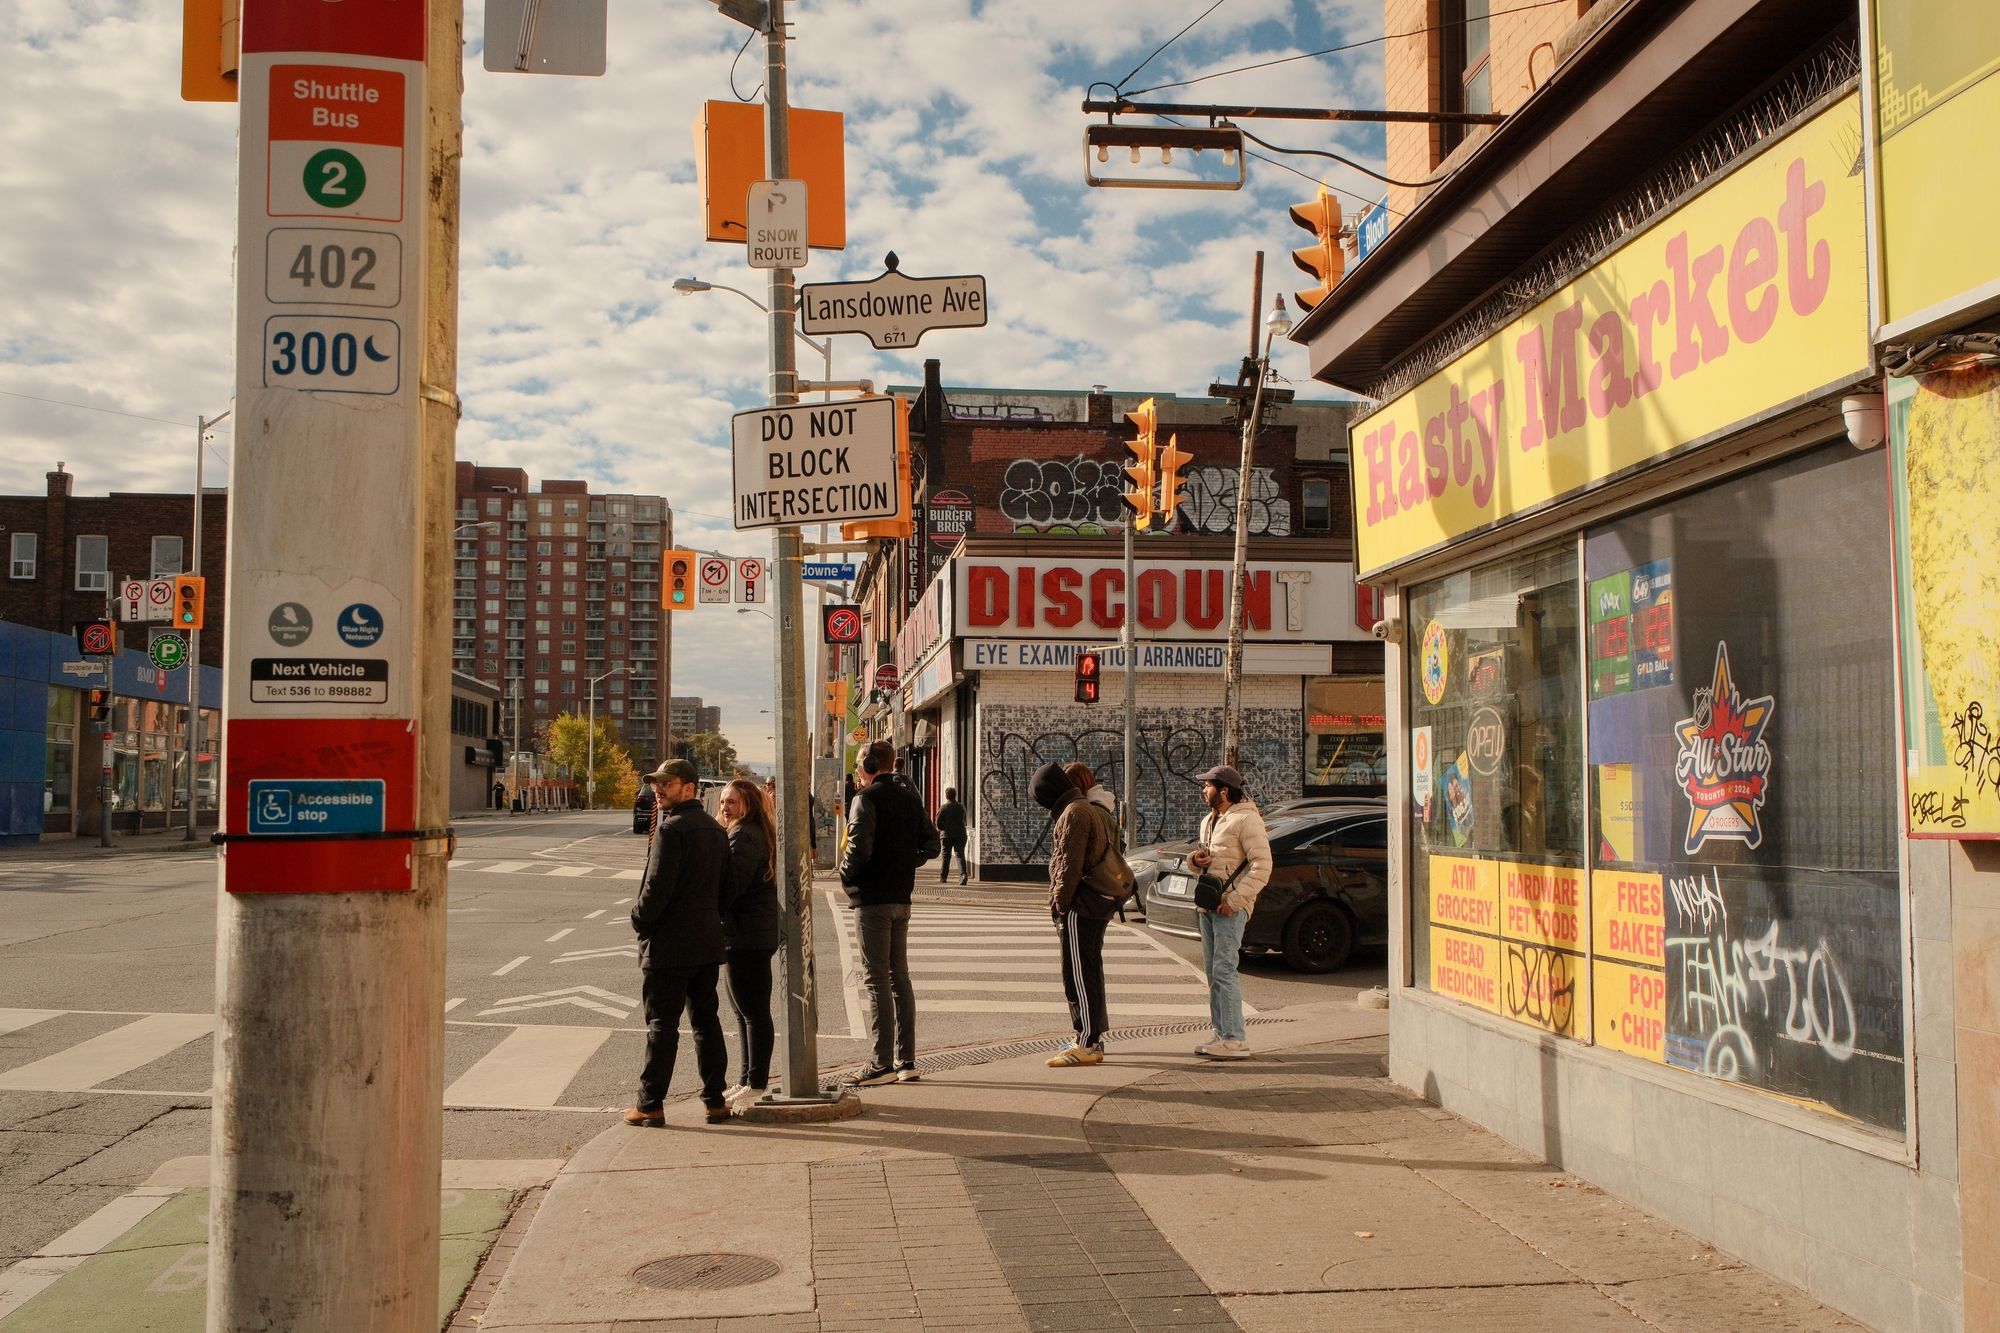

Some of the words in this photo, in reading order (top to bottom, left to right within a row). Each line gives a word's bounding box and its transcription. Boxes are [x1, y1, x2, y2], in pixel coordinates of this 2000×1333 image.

[293, 79, 380, 103] Shuttle
[312, 106, 360, 128] Bus
[320, 160, 347, 195] 2
[757, 229, 798, 243] SNOW
[1365, 212, 1385, 252] Bloor
[754, 247, 802, 261] ROUTE
[289, 244, 377, 291] 402
[807, 291, 933, 321] Lansdowne
[942, 286, 981, 314] Ave
[1516, 157, 1831, 452] Market
[884, 332, 906, 344] 671
[271, 331, 357, 377] 300
[761, 414, 794, 442] DO
[810, 408, 857, 438] NOT
[769, 447, 851, 479] BLOCK
[1364, 378, 1504, 527] Hasty
[741, 482, 888, 521] INTERSECTION
[930, 510, 973, 522] BURGER
[937, 521, 966, 533] BROS
[802, 564, 839, 577] downe
[841, 564, 853, 573] Ave
[968, 565, 1311, 632] DISCOUNT
[1600, 592, 1620, 616] MAX
[271, 625, 309, 634] Community
[345, 633, 375, 641] Network
[359, 626, 379, 635] Night
[161, 643, 177, 658] P
[976, 643, 1008, 665] EYE
[1019, 644, 1138, 667] EXAMITIO
[1143, 646, 1223, 668] ARRANGED
[137, 666, 155, 684] BMO
[272, 663, 306, 676] Next
[309, 663, 365, 677] Vehicle
[1654, 659, 1669, 673] BALL
[265, 685, 287, 696] Text
[289, 685, 311, 696] 536
[314, 685, 325, 696] to
[328, 686, 372, 697] 898882
[1086, 682, 1095, 699] 4
[1470, 724, 1501, 758] OPEN
[1679, 734, 1716, 779] All
[1716, 733, 1767, 778] Star
[297, 793, 373, 806] Accessible
[1696, 788, 1725, 801] TORONTO
[1734, 784, 1750, 796] 2024
[297, 810, 328, 822] stop
[1715, 816, 1739, 828] ROGERS
[1451, 864, 1476, 892] ATM
[1507, 872, 1580, 908] HARDWARE
[1437, 893, 1494, 926] GROCERY
[1617, 880, 1664, 917] FRES
[1508, 905, 1531, 933] PET
[1535, 909, 1578, 943] FOODS
[1445, 938, 1485, 970] BREAD
[1437, 965, 1495, 1004] MEDICINE
[1521, 968, 1567, 1008] SLUSH
[1629, 974, 1664, 1011] POP
[1621, 1012, 1663, 1051] CHIP
